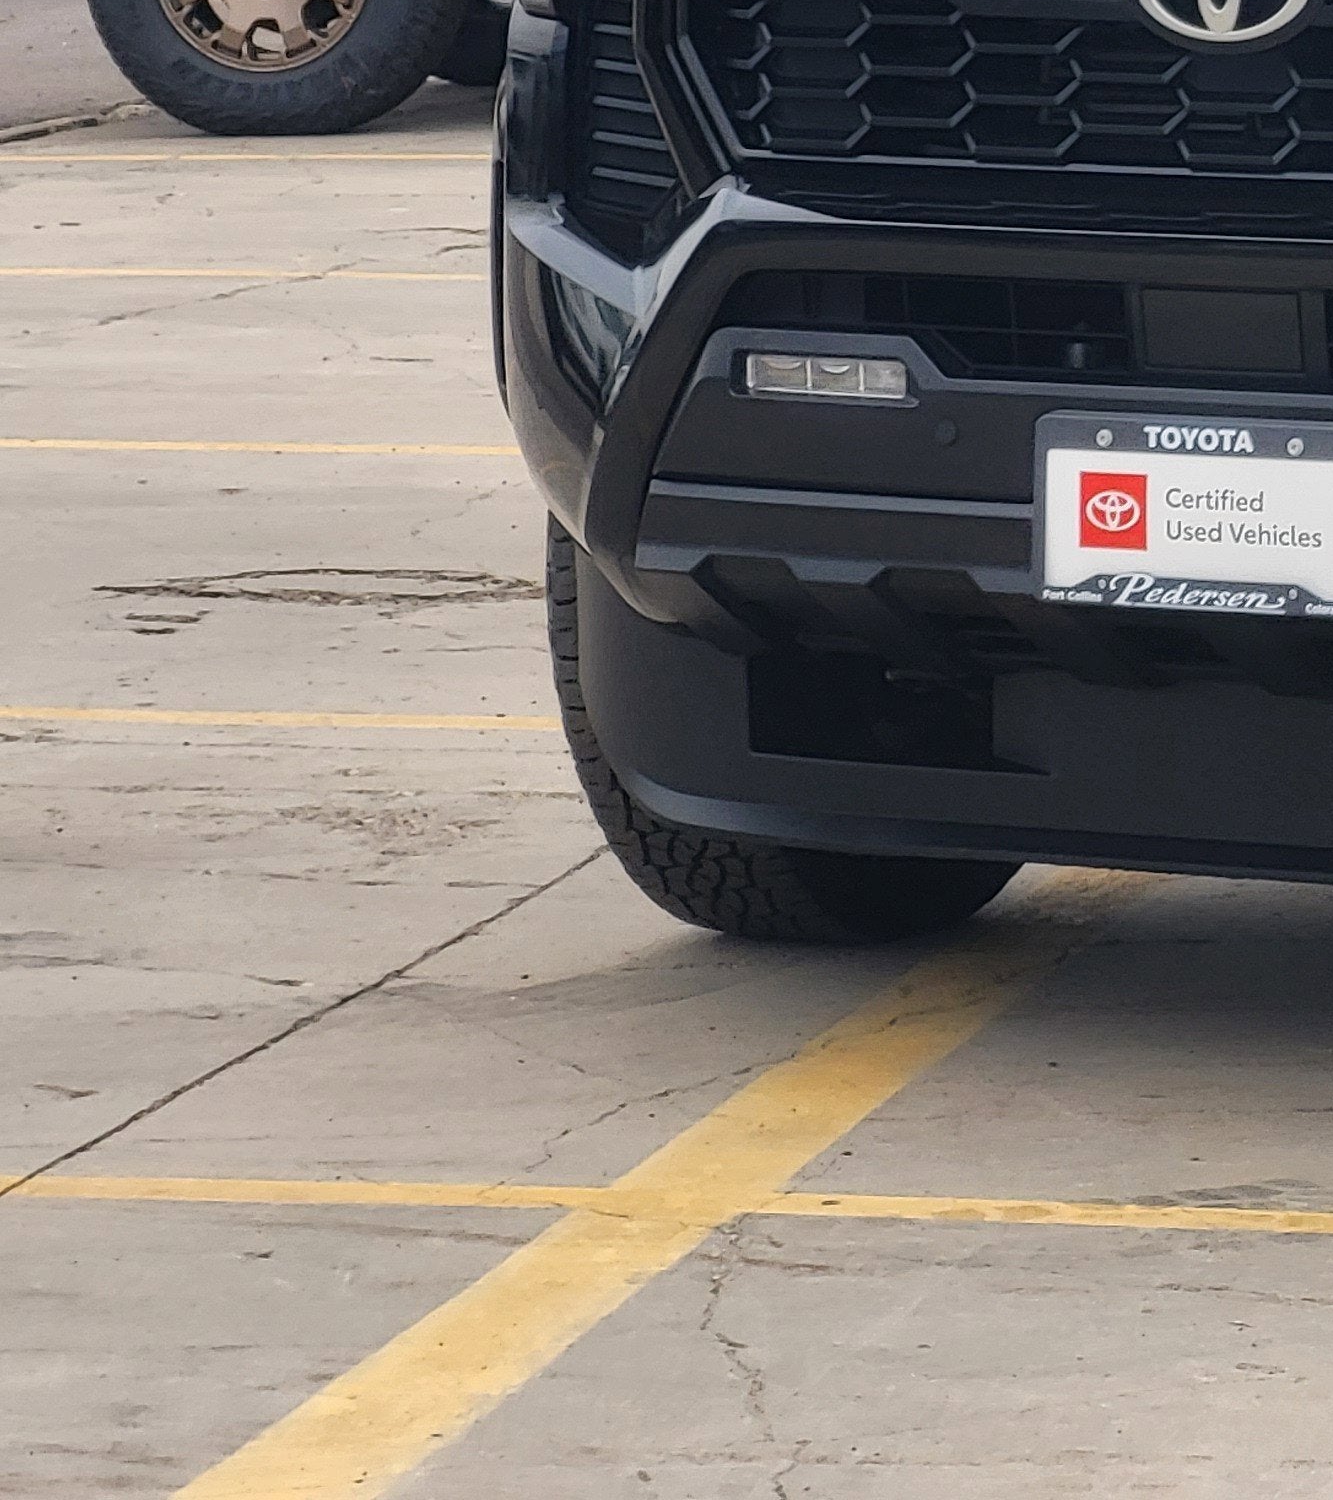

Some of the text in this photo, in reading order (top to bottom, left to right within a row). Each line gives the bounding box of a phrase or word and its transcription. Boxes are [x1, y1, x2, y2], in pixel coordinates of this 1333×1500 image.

[1143, 425, 1255, 454] TOYOTA
[1165, 488, 1265, 513] Certified
[1165, 519, 1323, 549] Used Vehicles
[1109, 573, 1286, 611] Pedersen
